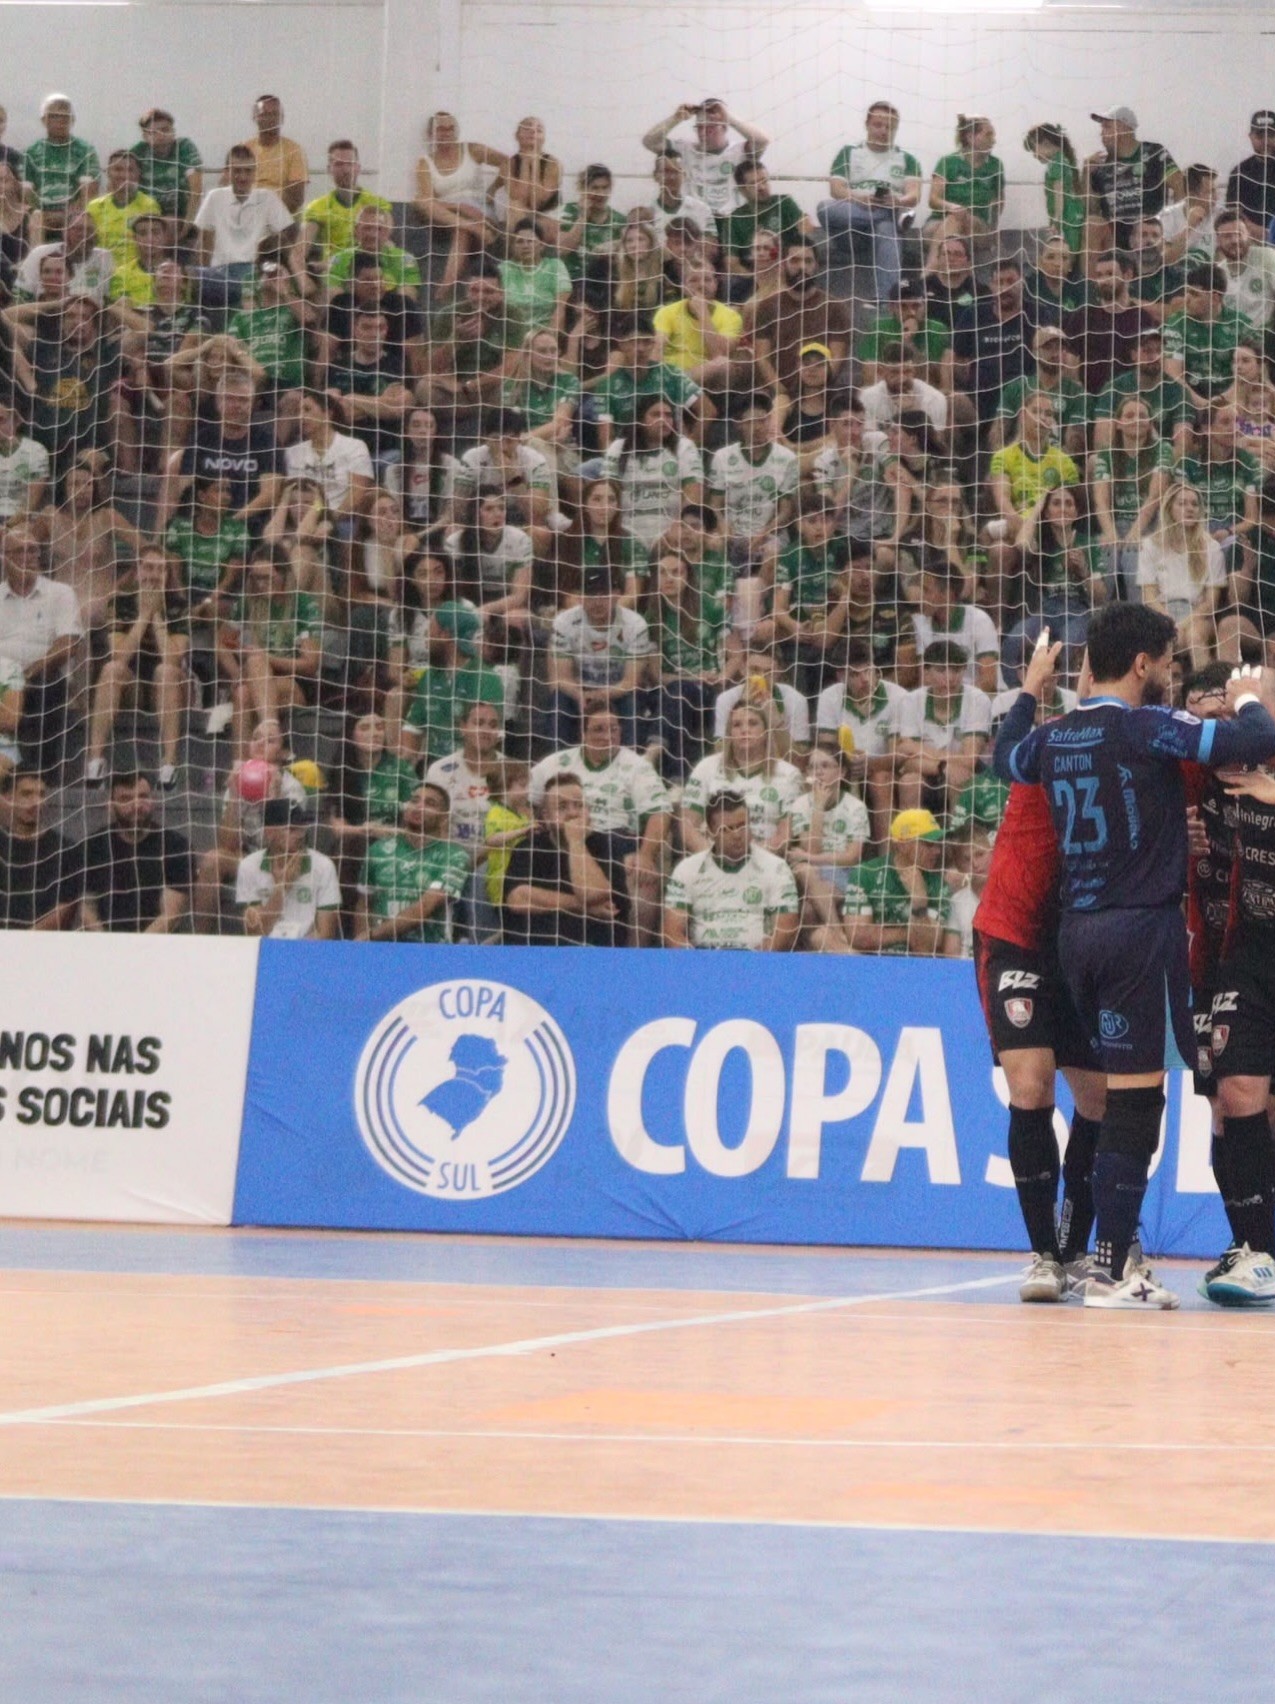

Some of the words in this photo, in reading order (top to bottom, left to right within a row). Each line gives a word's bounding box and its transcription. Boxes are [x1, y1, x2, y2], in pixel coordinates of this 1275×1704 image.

[205, 458, 258, 471] NOVO
[1054, 754, 1092, 773] CANTON
[1053, 777, 1109, 855] 23
[439, 986, 507, 1022] COPA
[86, 1034, 163, 1075] NAS
[16, 1086, 172, 1129] SOCIAIS
[607, 1016, 962, 1185] COPA
[437, 1162, 481, 1192] SUL
